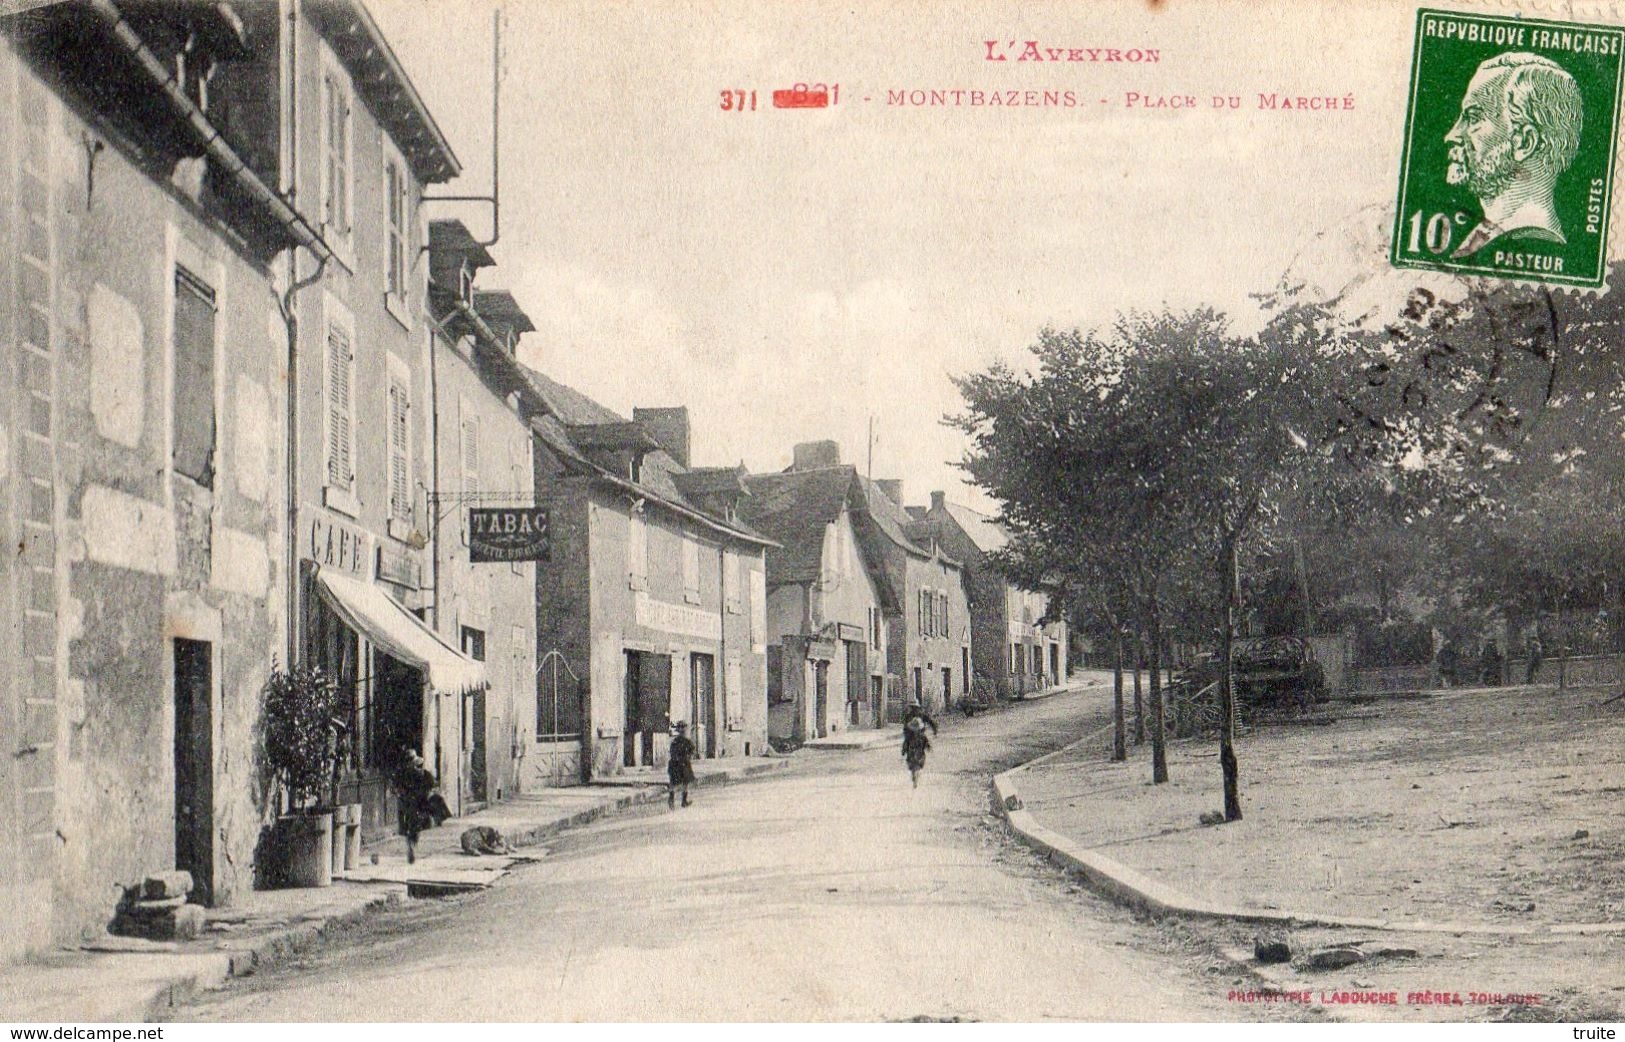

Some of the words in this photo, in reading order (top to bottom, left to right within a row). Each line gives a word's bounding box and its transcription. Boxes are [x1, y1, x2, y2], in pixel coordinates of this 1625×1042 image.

[1531, 29, 1619, 55] FRANÇAISE
[1586, 178, 1604, 234] POSTES
[1494, 251, 1564, 273] PASTEUR
[473, 512, 547, 533] TABAC
